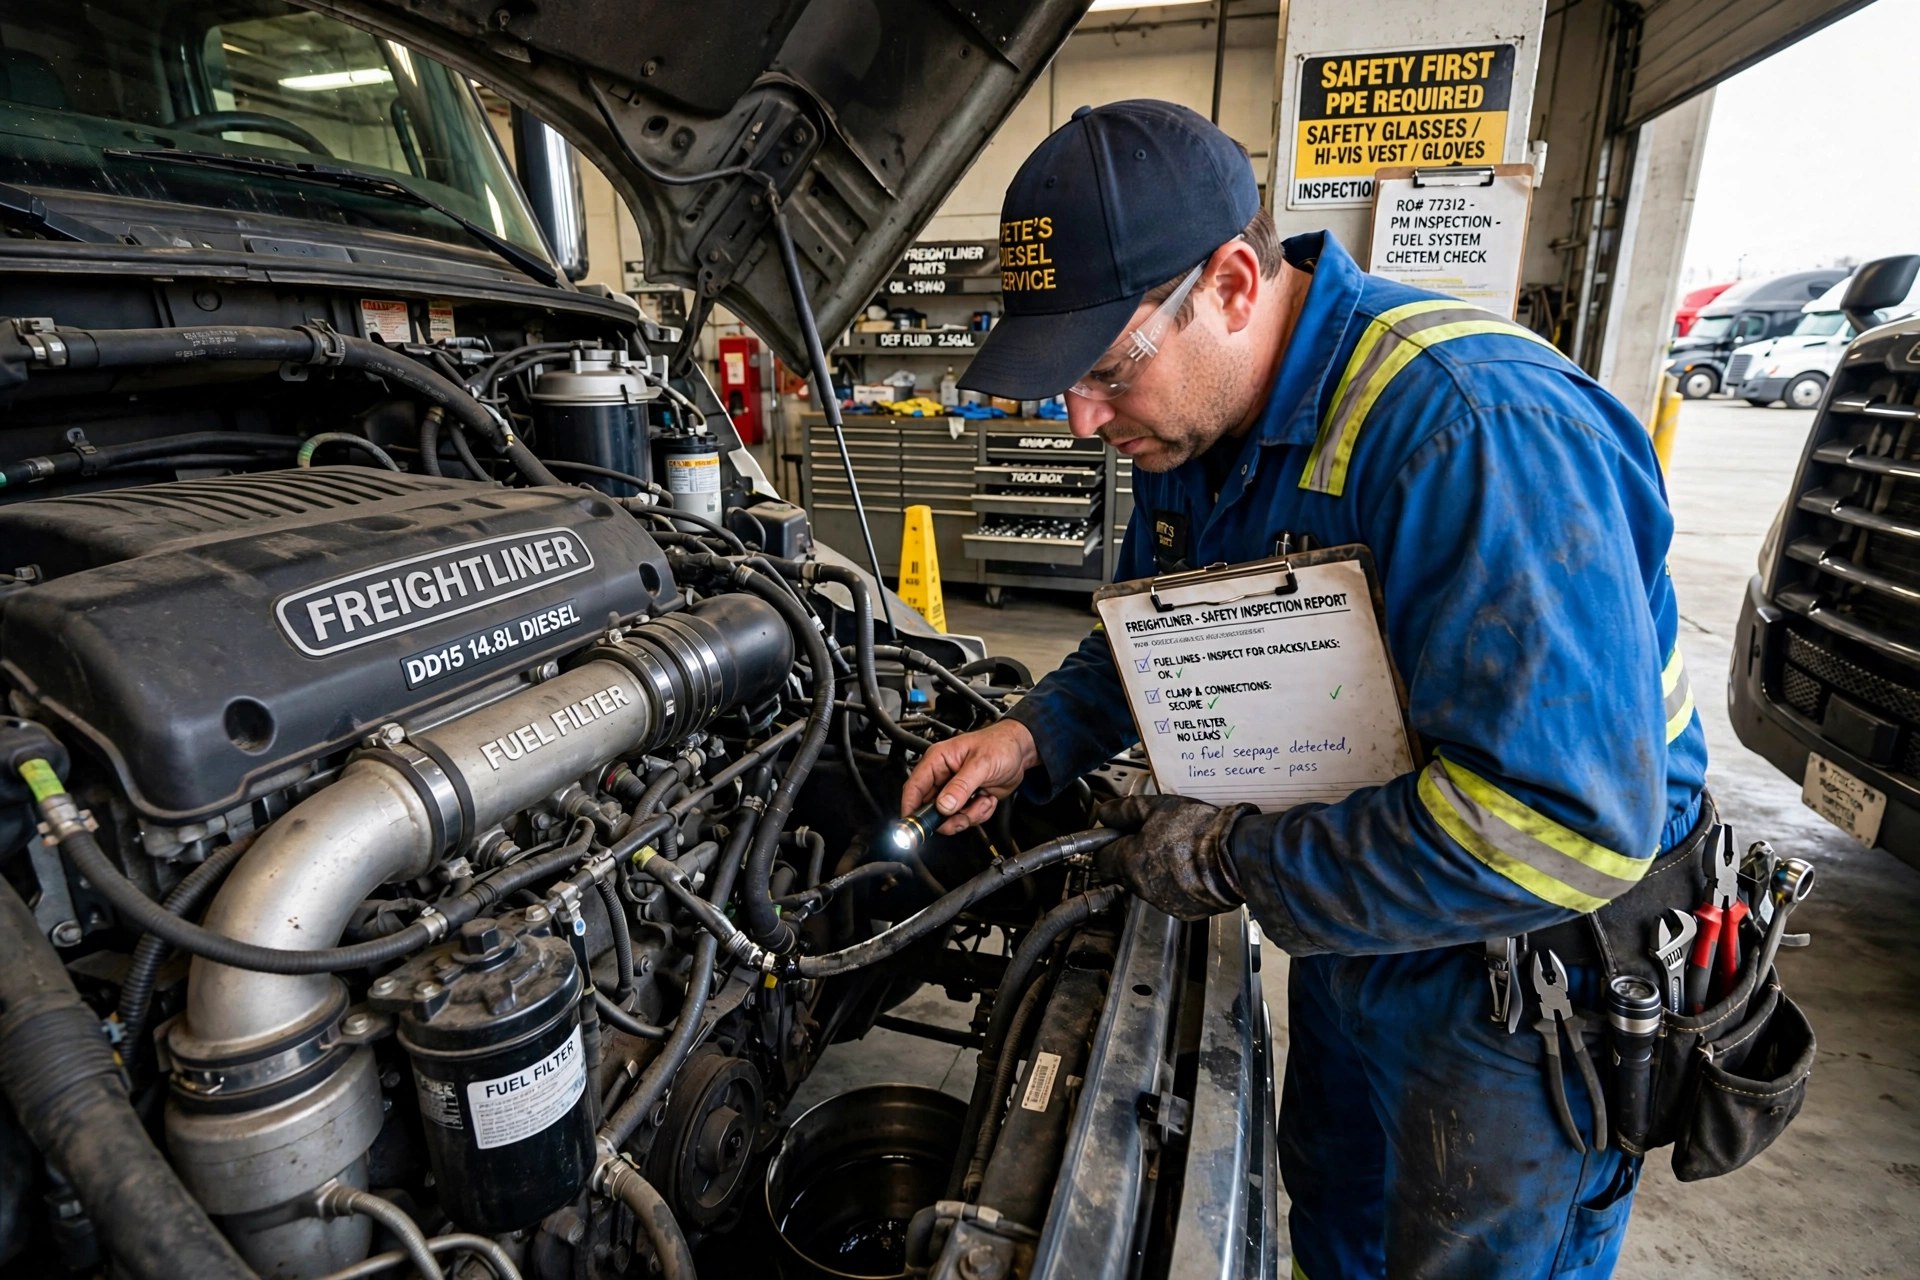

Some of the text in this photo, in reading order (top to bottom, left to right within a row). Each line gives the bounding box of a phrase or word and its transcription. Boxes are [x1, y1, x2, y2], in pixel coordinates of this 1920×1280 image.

[1321, 51, 1495, 88] SAFETY FIRST
[1326, 84, 1484, 115] PPE REQUIRED
[1306, 117, 1481, 145] SAFETY GLASSES /
[1315, 140, 1485, 165] HI-VIS VEST / GLOVES
[1396, 199, 1424, 212] RO#
[1428, 198, 1466, 211] 77312
[1391, 216, 1410, 228] PM
[1414, 216, 1492, 229] INSPECTION
[1392, 233, 1481, 246] FUEL SYSTEM
[1386, 250, 1487, 264] CHETEM CHECK
[908, 262, 946, 275] PARTS
[1001, 268, 1056, 292] ERVICE
[902, 334, 932, 346] FLUID
[1018, 438, 1074, 448] SNAP-ON
[1011, 472, 1064, 484] TOOLBOX
[305, 536, 579, 642] FREIGHTLINER
[1126, 614, 1194, 633] FREIGHTLINER
[1202, 607, 1238, 625] SAFETY
[1240, 600, 1304, 618] INSPECTION
[1305, 593, 1348, 608] REPORT
[406, 604, 580, 685] DD15 14.8L DIESEL
[1154, 657, 1176, 667] FUEL
[1208, 646, 1244, 661] INSPECT
[1246, 646, 1266, 657] FOR
[1158, 670, 1173, 680] OK
[1204, 681, 1272, 696] CONNECTIONS:
[1168, 701, 1204, 712] SECURE
[480, 684, 630, 770] FUEL FILTER
[1174, 718, 1227, 730] FUEL FILTER
[1177, 733, 1191, 742] NO
[1182, 737, 1352, 761] no fuel seepage detected,
[1188, 766, 1216, 778] lines
[1225, 765, 1266, 776] secure
[1289, 762, 1318, 777] pass
[486, 1040, 574, 1098] FUEL FILTER
